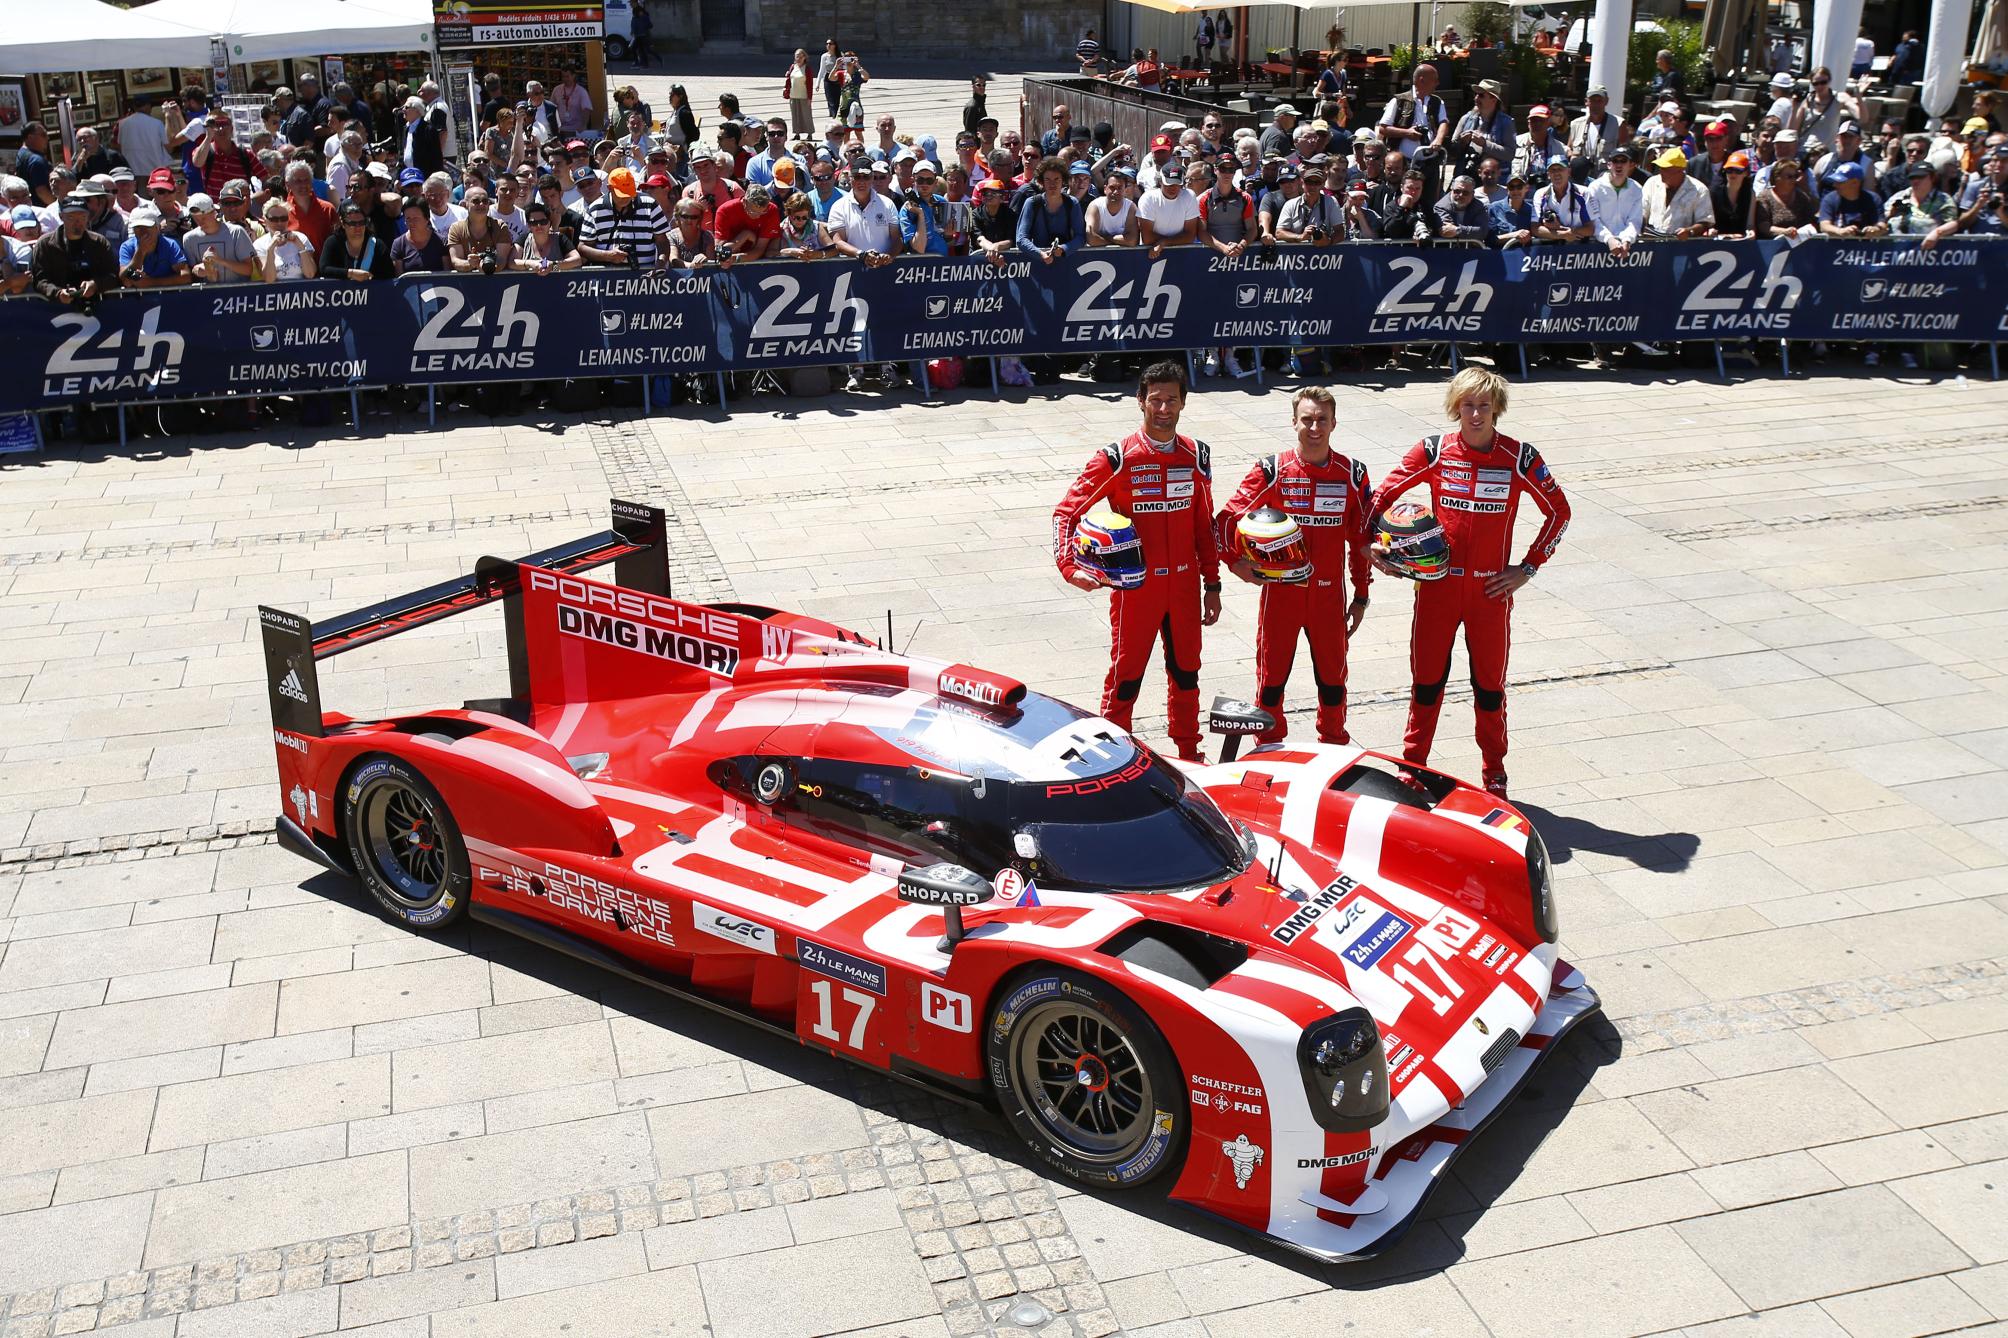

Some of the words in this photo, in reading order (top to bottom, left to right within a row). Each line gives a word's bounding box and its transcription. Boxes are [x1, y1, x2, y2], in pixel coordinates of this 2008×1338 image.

[480, 25, 596, 40] rs-automobiles.com
[1520, 251, 1653, 273] 24H-LEMANS.COM
[1833, 250, 1978, 266] 24H-LEMANS.COM
[895, 262, 1031, 284] 24H-LEMANS.COM
[1681, 250, 1803, 310] 24h
[566, 276, 710, 298] 24H-LEMANS.COM
[1065, 258, 1182, 322] 24h
[1264, 288, 1313, 304] #LM24
[1374, 256, 1494, 315] 24h
[1575, 285, 1623, 302] #LM24
[1889, 283, 1944, 298] #LM24
[213, 289, 368, 316] 24H-LEMANS.COM
[750, 272, 869, 338] 24h
[953, 296, 1003, 314] #LM24
[414, 284, 540, 351] 24h
[630, 313, 683, 330] #LM24
[1368, 318, 1402, 333] LE
[1405, 315, 1482, 332] MANS
[1521, 316, 1640, 334] LEMANS-TV.COM
[1675, 314, 1710, 330] LE
[1712, 313, 1792, 330] MANS
[1832, 314, 1960, 330] LEMANS-TV.COM
[46, 305, 185, 375] 24h
[284, 326, 340, 345] #LM24
[904, 328, 1024, 350] LEMANS-TV.COM
[1062, 325, 1094, 342] LE
[1098, 322, 1174, 340] MANS
[1213, 320, 1332, 338] LEMANS-TV.COM
[578, 346, 706, 366] LEMANS-TV.COM
[746, 342, 780, 358] LE
[784, 336, 862, 356] MANS
[230, 360, 368, 382] LEMANS-TV.COM
[410, 354, 446, 372] LE
[452, 352, 534, 371] MANS
[44, 377, 82, 396] LE
[88, 368, 180, 394] MANS
[612, 504, 650, 518] CHOPARD
[1134, 503, 1164, 512] DMG
[1441, 498, 1470, 510] DMG
[530, 571, 739, 641] PORSCHE
[260, 610, 300, 628] CHOPARD
[559, 606, 638, 648] DMG
[644, 628, 738, 676] MORI
[762, 624, 792, 662] HY
[278, 686, 308, 704] adidas
[940, 675, 984, 703] Mobil
[1212, 719, 1265, 732] CHOPARD
[274, 730, 300, 750] Mobil
[356, 763, 387, 784] MICHELIN
[512, 866, 672, 932] INTELLIGENT
[544, 863, 670, 918] PORSCHE
[898, 882, 979, 904] CHOPARD
[409, 908, 443, 924] MICHELIN
[1273, 906, 1322, 944] DMG
[1334, 902, 1366, 934] WEC
[715, 916, 766, 940] WEC
[1433, 915, 1471, 942] P1
[1350, 943, 1374, 964] 24h
[1367, 935, 1382, 950] LE
[1378, 919, 1400, 943] MANS
[804, 946, 826, 965] 24h
[828, 960, 844, 970] LE
[844, 965, 880, 984] MANS
[1392, 942, 1466, 1017] 17
[1010, 980, 1057, 1010] MICHELIN
[812, 980, 876, 1050] 17
[930, 990, 963, 1027] P1
[1396, 1054, 1424, 1083] CHOPARD
[1192, 1074, 1262, 1096] SCHAEFFLER
[1234, 1102, 1262, 1114] FAG
[1122, 1139, 1163, 1179] MICHELIN
[1298, 1157, 1340, 1169] DMG
[1342, 1146, 1379, 1166] MORI
